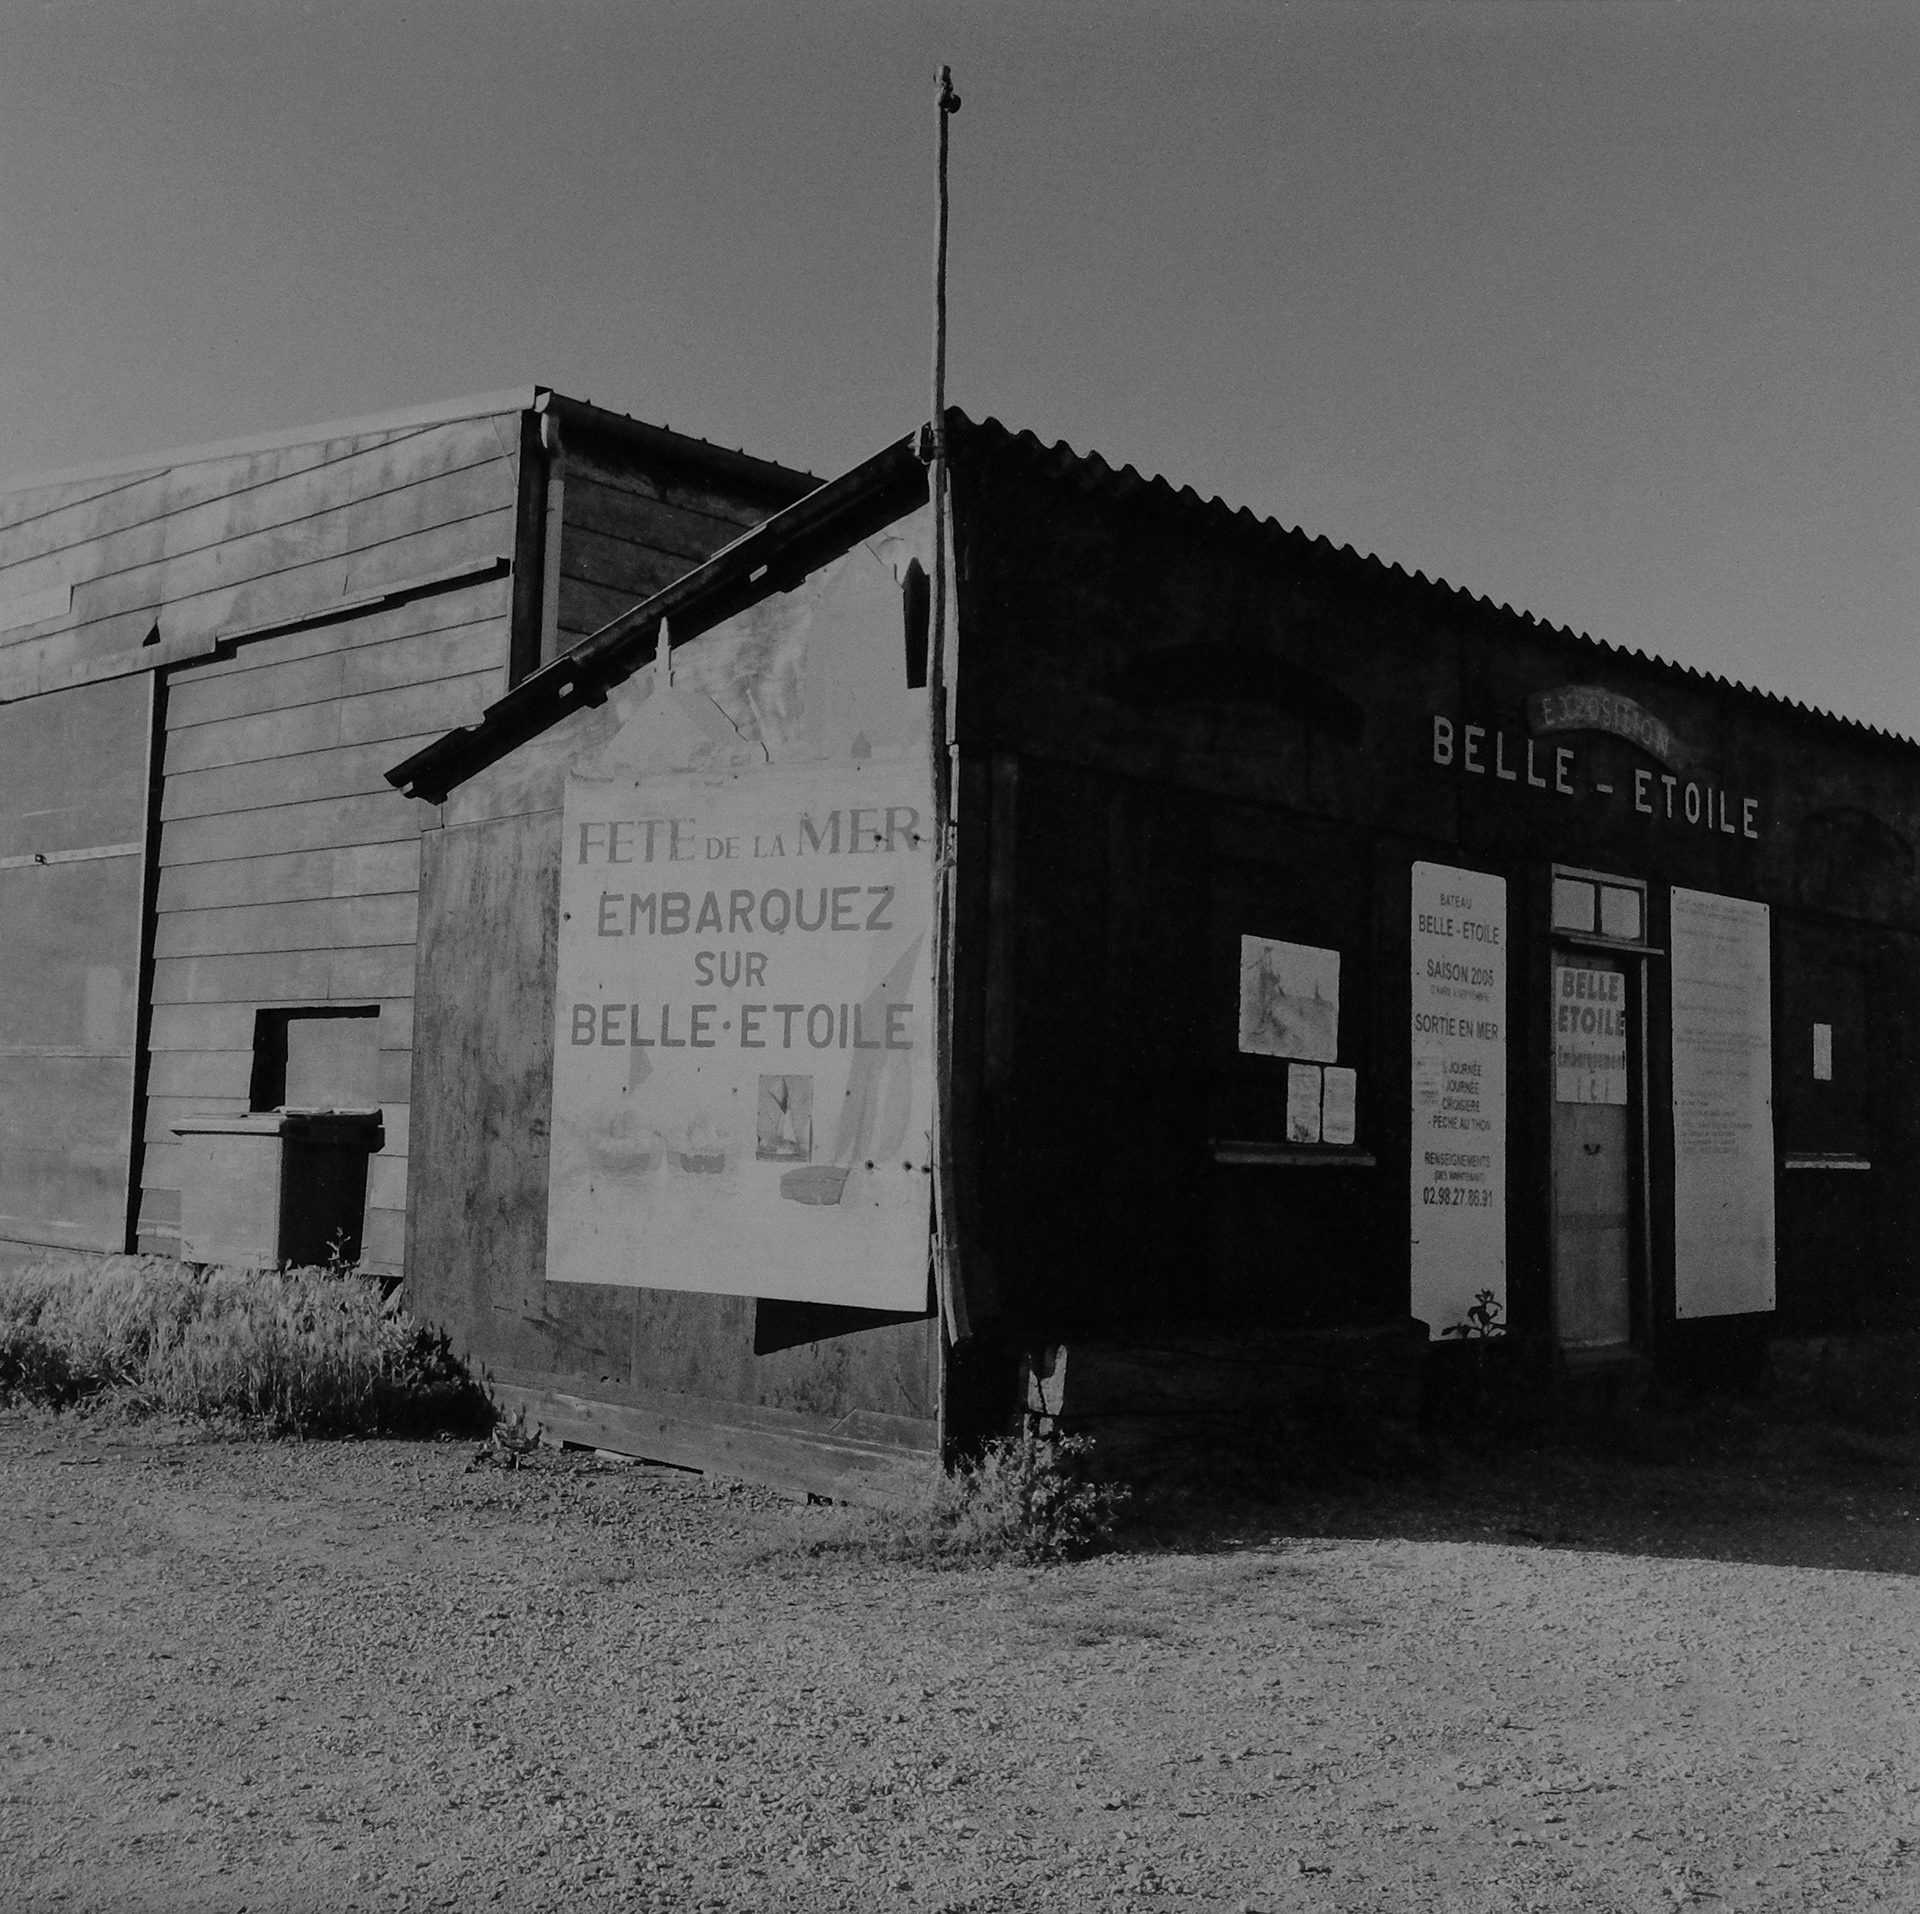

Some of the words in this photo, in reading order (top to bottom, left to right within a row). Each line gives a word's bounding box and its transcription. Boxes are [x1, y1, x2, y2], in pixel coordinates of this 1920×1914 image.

[1433, 714, 1574, 795] BELLE
[1635, 768, 1758, 839] ETOILE
[576, 817, 697, 865] FETE
[705, 836, 741, 861] DE
[753, 834, 787, 859] LA
[796, 805, 922, 857] MER
[597, 885, 897, 938] EMBARQUEZ
[1440, 893, 1472, 910] BATEAU
[1419, 914, 1453, 938] BELLE
[1463, 921, 1499, 945] ETOILE
[693, 950, 769, 988] SUR
[1427, 957, 1469, 984] SAISON
[1562, 969, 1620, 1002] BELLE
[1415, 1011, 1456, 1036] SORTIE
[1459, 1019, 1474, 1039] EN
[1476, 1021, 1499, 1040] MER
[1557, 1004, 1624, 1038] ETOILE
